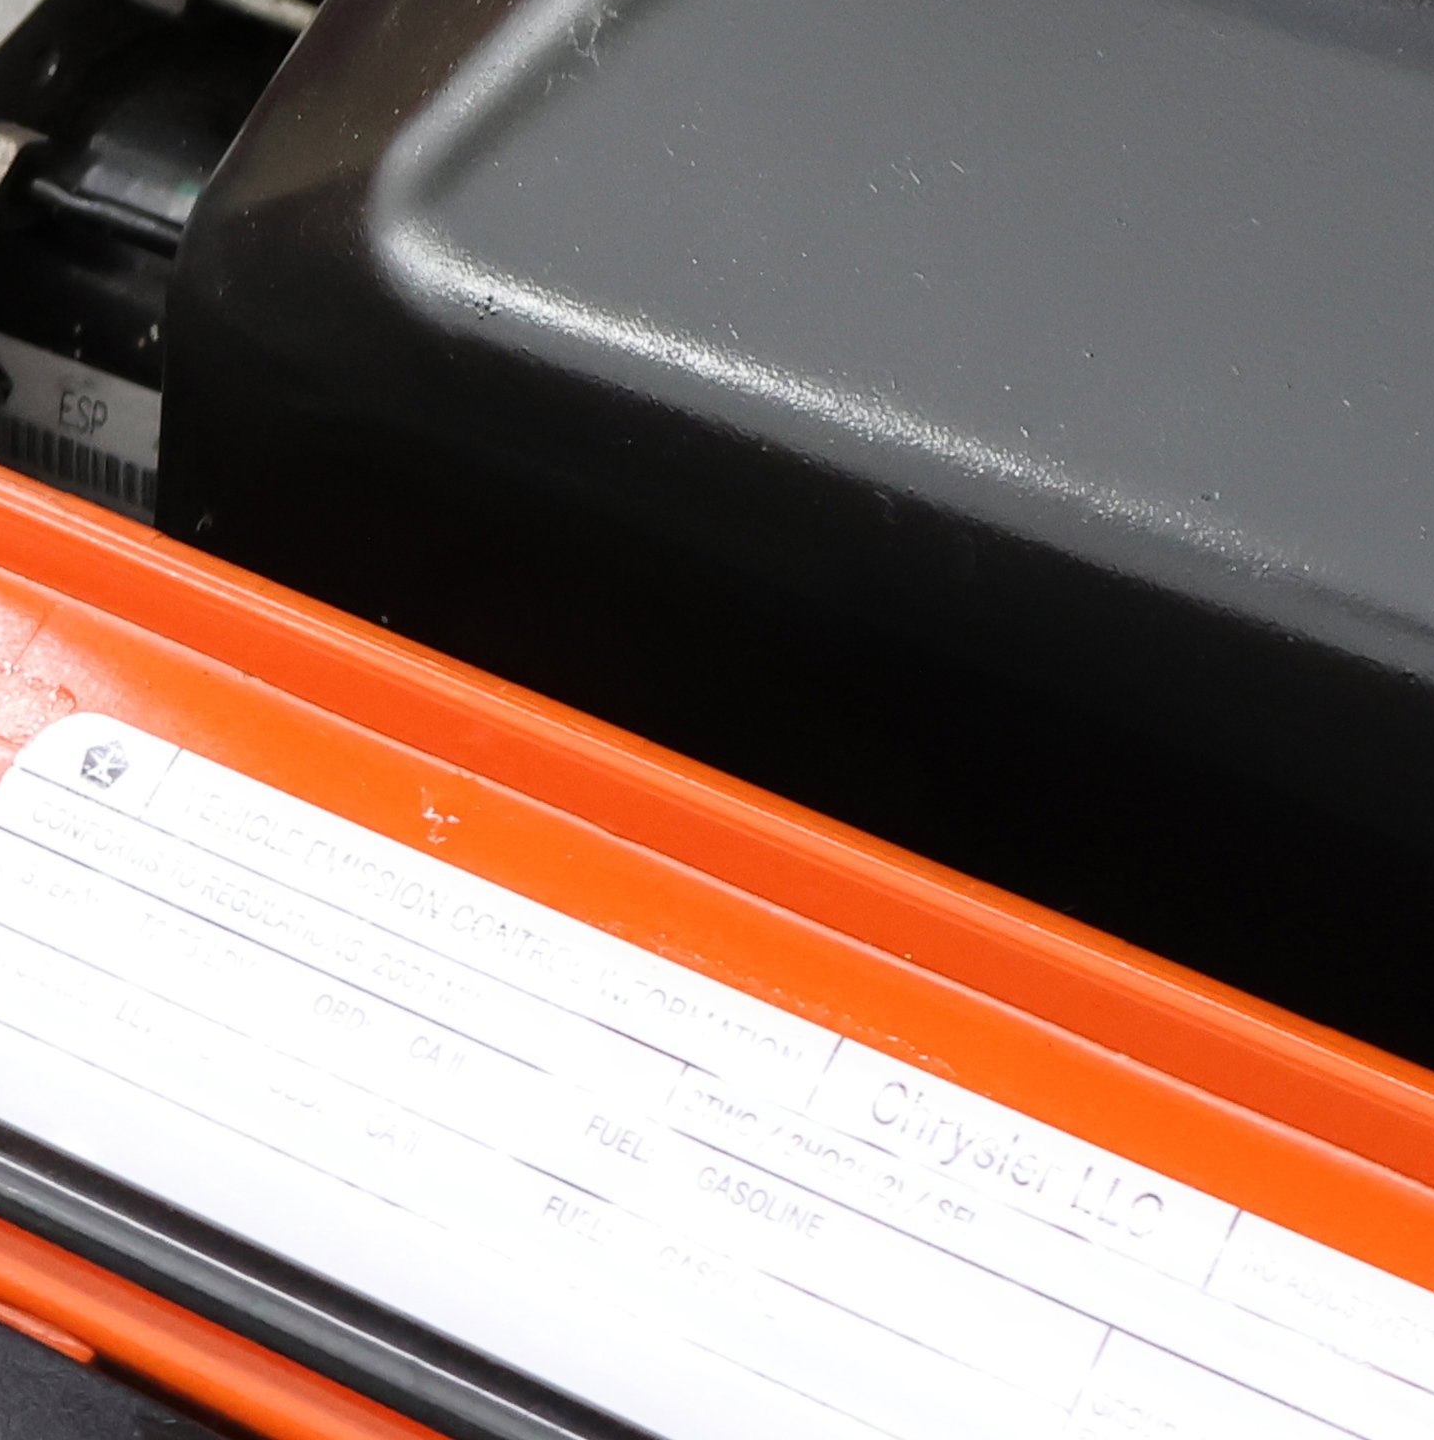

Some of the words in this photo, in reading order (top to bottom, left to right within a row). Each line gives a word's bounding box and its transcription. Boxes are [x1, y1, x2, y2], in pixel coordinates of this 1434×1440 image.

[58, 390, 109, 435] ESP
[301, 835, 446, 922] EMISSION
[582, 1112, 658, 1165] FUEL:
[692, 1161, 826, 1241] GASOLINE
[861, 1073, 1071, 1213] Chrysler
[1067, 1162, 1168, 1243] LLC
